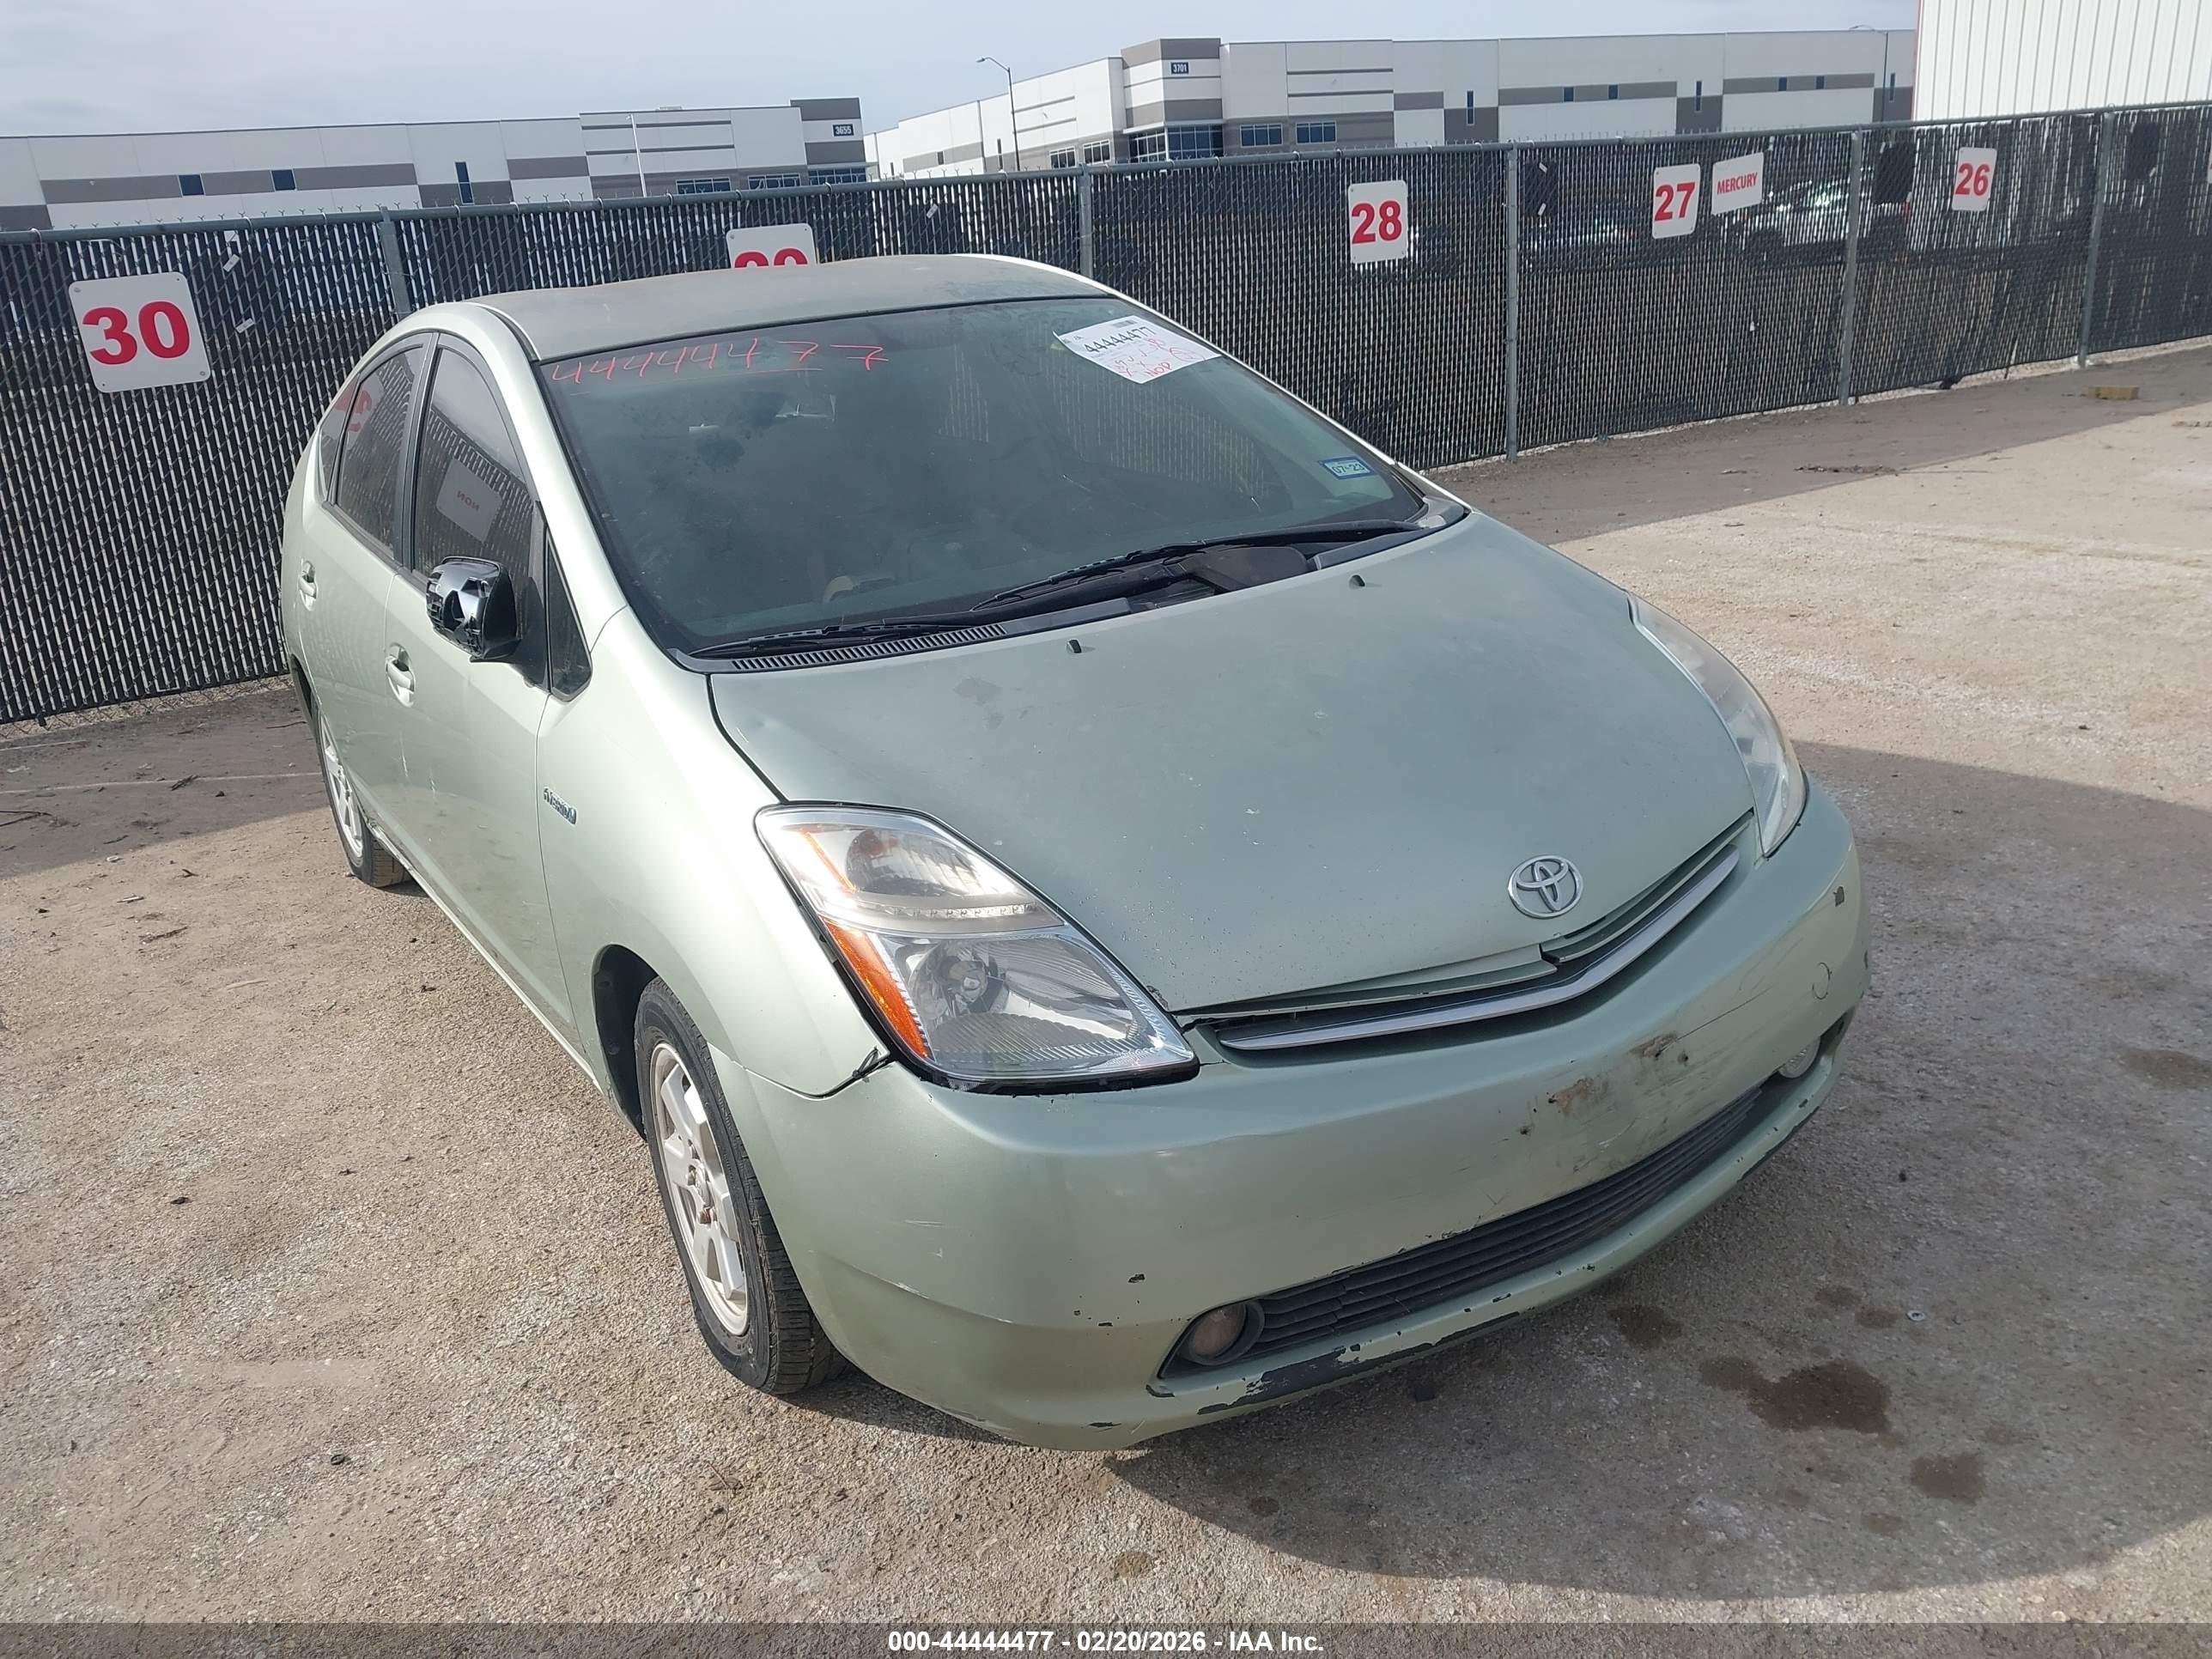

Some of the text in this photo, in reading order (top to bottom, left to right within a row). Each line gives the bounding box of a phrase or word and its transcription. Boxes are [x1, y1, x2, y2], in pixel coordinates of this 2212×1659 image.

[1173, 64, 1187, 73] 3701
[836, 125, 852, 135] 3655
[1717, 172, 1758, 194] MERCURY
[1954, 162, 1990, 197] 26
[1655, 182, 1695, 222] 27
[1351, 200, 1402, 244] 28
[82, 301, 191, 366] 30
[1084, 325, 1157, 354] 44444477
